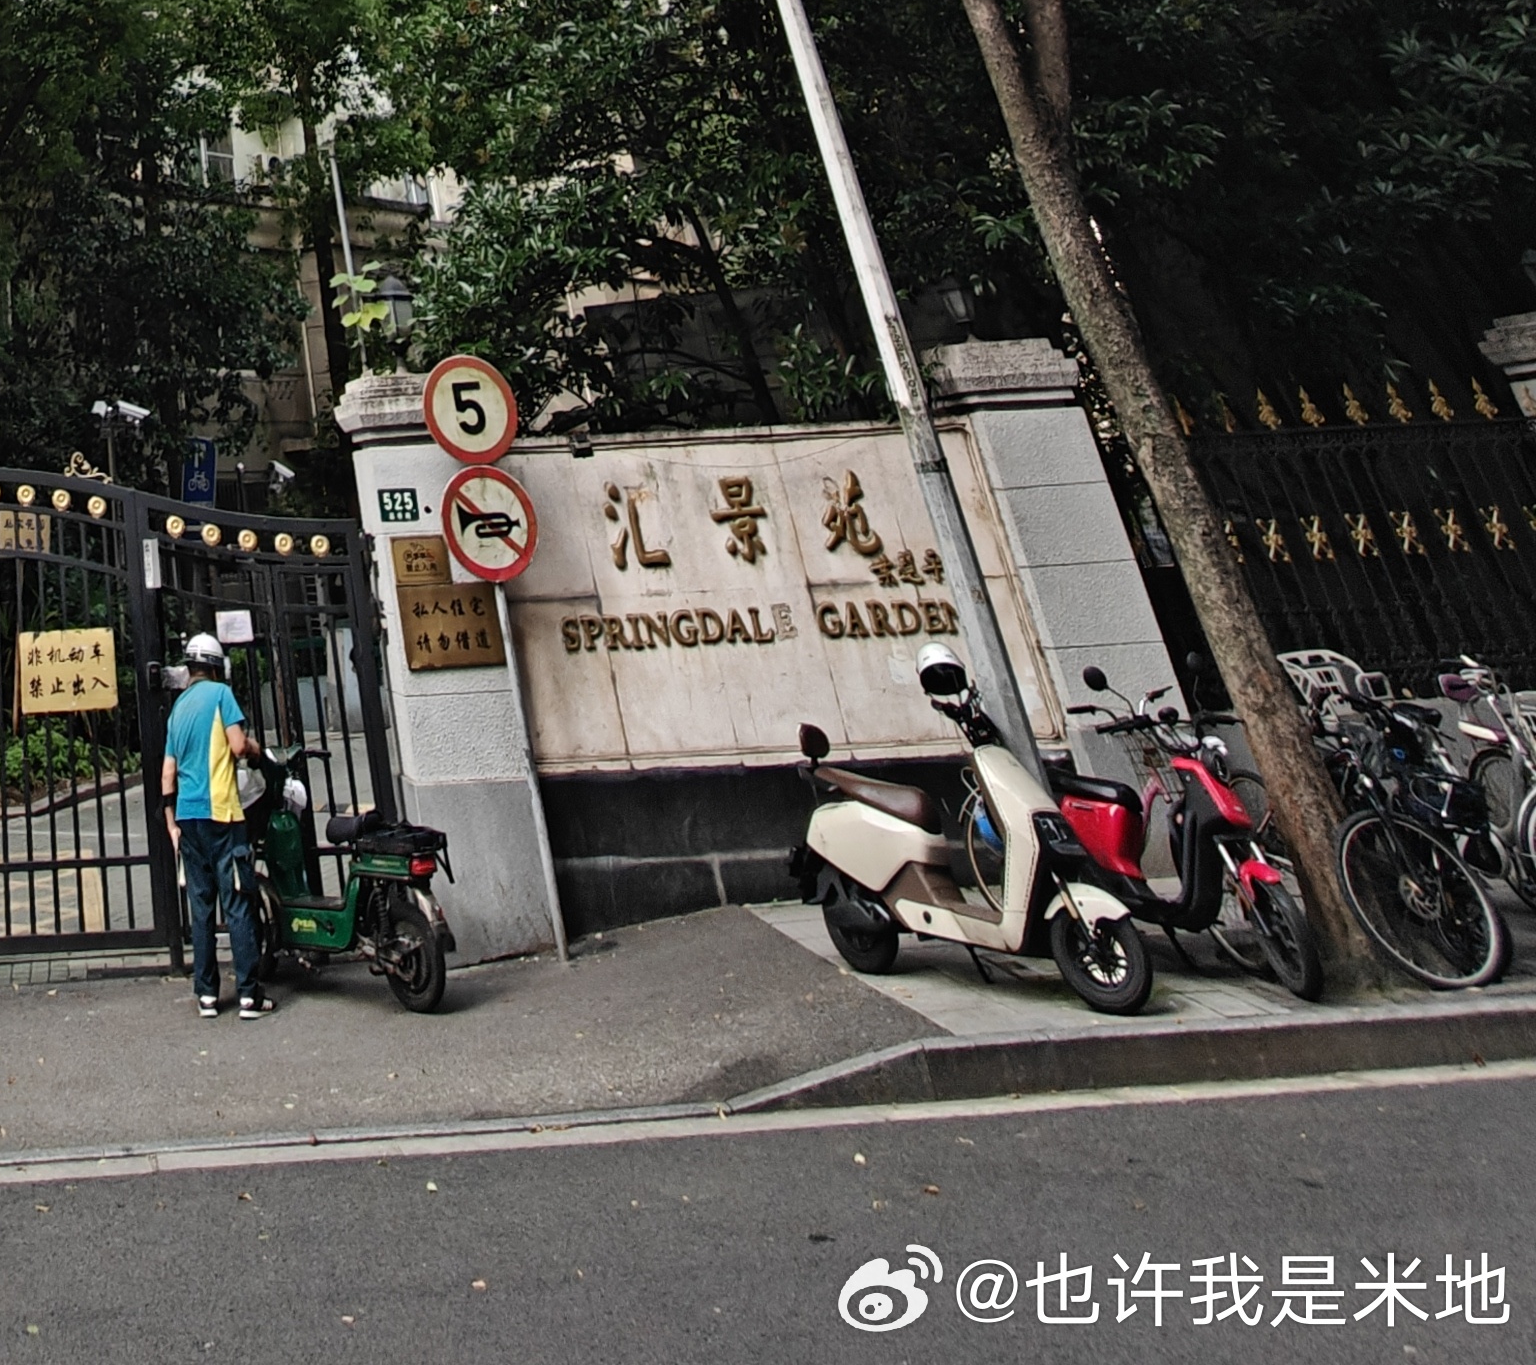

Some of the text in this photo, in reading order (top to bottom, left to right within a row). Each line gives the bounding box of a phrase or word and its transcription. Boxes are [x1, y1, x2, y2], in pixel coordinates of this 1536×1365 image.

[451, 380, 487, 436] 5
[382, 491, 414, 511] 525
[602, 468, 884, 570] 汇景苑
[412, 595, 486, 619] 私人住宅
[416, 629, 492, 653] 请勿借道
[561, 602, 798, 655] SPRINGDALE
[27, 640, 106, 667] 非机动车
[28, 673, 111, 699] 禁止出入
